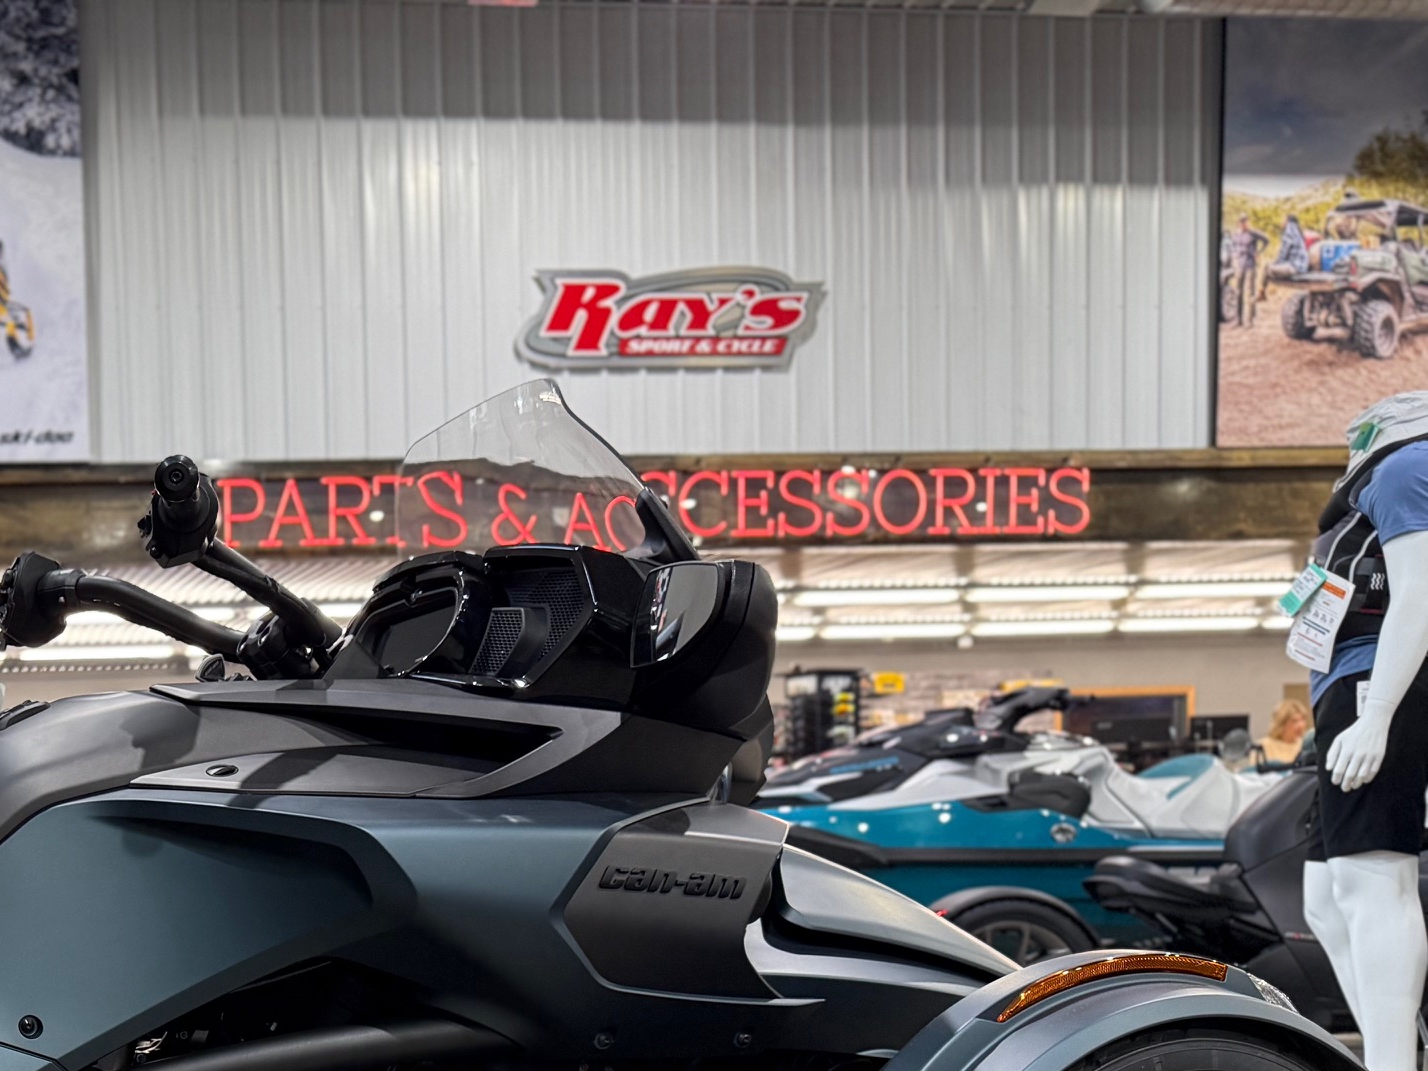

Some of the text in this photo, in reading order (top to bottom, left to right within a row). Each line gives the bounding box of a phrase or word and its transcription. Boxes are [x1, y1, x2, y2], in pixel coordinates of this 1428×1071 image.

[626, 338, 779, 355] SPORT & CYCLE
[217, 467, 1091, 553] PARTS & ACCESSORIES
[599, 864, 748, 900] can-am
